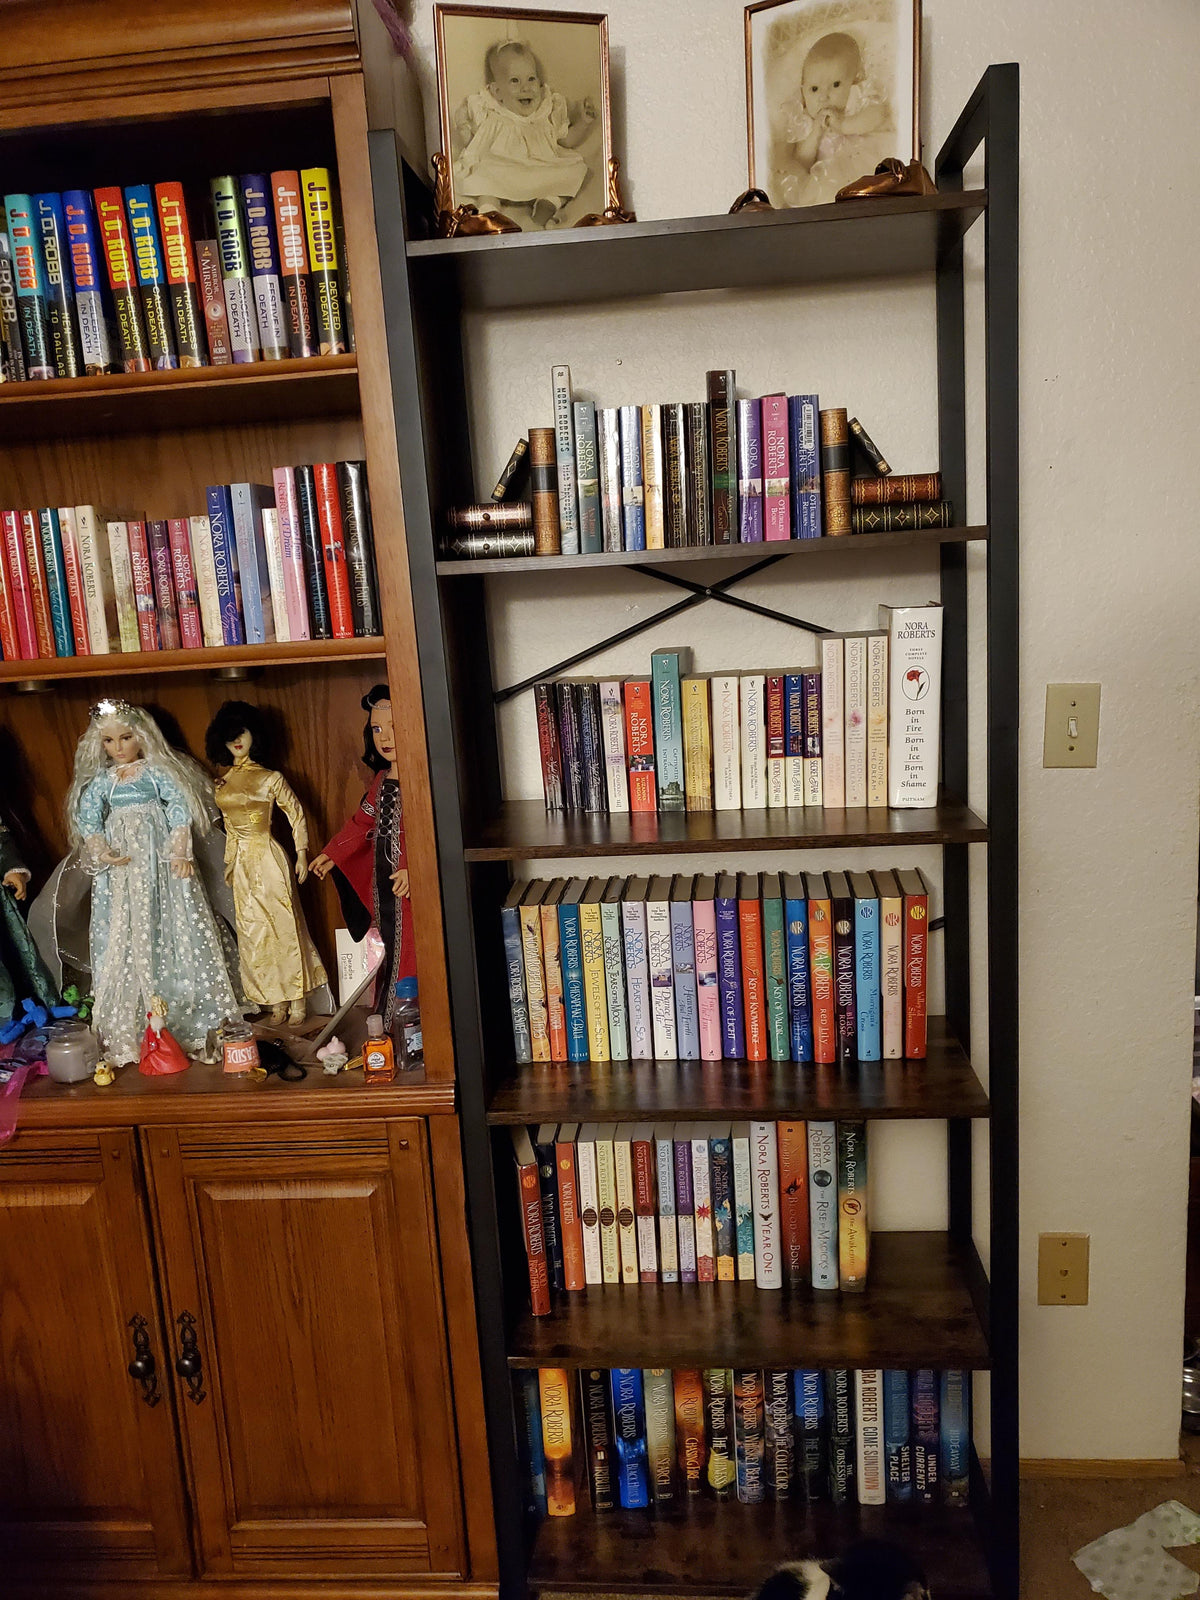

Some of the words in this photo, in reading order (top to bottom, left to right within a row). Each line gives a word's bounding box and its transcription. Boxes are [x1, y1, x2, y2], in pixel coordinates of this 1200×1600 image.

[166, 234, 189, 278] ROBB
[250, 226, 272, 269] ROBB
[282, 225, 303, 268] ROBB
[312, 220, 333, 263] ROBB
[107, 240, 130, 282] ROBB
[202, 259, 214, 302] MIRROR
[319, 282, 325, 293] IN
[51, 310, 58, 324] TO
[118, 300, 124, 310] IN
[259, 295, 269, 329] DEATH
[320, 297, 330, 330] DEATH
[330, 281, 340, 330] DEVOTED
[119, 313, 131, 350] DEATH
[54, 333, 65, 376] DALLAS
[715, 408, 730, 433] NORA
[577, 434, 586, 478] ROBERTS
[585, 440, 594, 471] NORA
[716, 437, 731, 471] ROBERTS
[749, 438, 758, 469] NORA
[768, 431, 777, 476] ROBERTS
[777, 436, 785, 468] NORA
[210, 512, 224, 547] NORA
[81, 535, 91, 559] NORA
[84, 562, 96, 598] ROBERTS
[132, 552, 144, 592] ROBERTS
[141, 558, 150, 585] NORA
[173, 548, 185, 588] ROBERTS
[182, 555, 191, 582] NORA
[215, 551, 230, 596] ROBERTS
[897, 630, 935, 639] ROBERTS
[904, 622, 928, 630] NORA
[872, 641, 880, 666] NORA
[660, 680, 670, 703] NORA
[872, 669, 880, 707] ROBERTS
[631, 712, 641, 752] ROBERTS
[639, 718, 648, 746] NORA
[661, 707, 672, 741] ROBERTS
[564, 918, 576, 937] NORA
[565, 940, 578, 968] ROBERTS
[583, 929, 594, 964] ROBERTS
[592, 932, 602, 960] NORA
[605, 936, 614, 970] ROBERTS
[611, 940, 620, 967] NORA
[625, 928, 636, 969] ROBERTS
[634, 932, 644, 965] NORA
[650, 931, 660, 968] ROBERTS
[661, 934, 670, 963] NORA
[696, 929, 707, 964] ROBERTS
[705, 933, 715, 960] NORA
[791, 946, 806, 969] NORA
[814, 935, 829, 960] NORA
[838, 946, 852, 970] NORA
[910, 934, 923, 954] NORA
[345, 953, 353, 980] Paradise
[908, 958, 925, 987] ROBERTS
[590, 969, 600, 1000] JEWELS
[632, 978, 642, 1004] HEART
[774, 987, 782, 1000] KEY
[790, 972, 807, 1006] ROBERTS
[814, 963, 830, 1000] ROBERTS
[835, 972, 853, 1006] ROBERTS
[594, 1002, 600, 1011] OF
[655, 994, 663, 1005] The
[662, 990, 671, 1016] Dance
[725, 990, 736, 1005] KEY
[728, 1007, 735, 1016] OF
[775, 1002, 782, 1010] OF
[655, 1007, 664, 1024] Air
[663, 1018, 673, 1039] Upon
[727, 1018, 736, 1040] LIGHT
[775, 1011, 784, 1035] VALOR
[594, 1027, 605, 1047] SUN
[635, 1026, 645, 1042] SEA
[636, 1146, 646, 1168] NORA
[757, 1135, 769, 1164] NORA
[810, 1129, 822, 1168] ROBERTS
[822, 1135, 833, 1164] NORA
[845, 1132, 856, 1158] NORA
[638, 1171, 646, 1204] ROBERTS
[757, 1169, 771, 1209] ROBERTS
[846, 1160, 857, 1195] ROBERTS
[526, 1201, 538, 1224] NORA
[528, 1226, 543, 1255] ROBERTS
[761, 1223, 773, 1249] YEAR
[764, 1252, 774, 1274] ONE
[545, 1383, 563, 1407] NORA
[620, 1376, 635, 1402] NORA
[710, 1373, 725, 1395] NORA
[741, 1373, 757, 1395] NORA
[772, 1373, 788, 1395] NORA
[803, 1373, 818, 1395] NORA
[835, 1370, 847, 1394] NORA
[708, 1397, 728, 1429] ROBERTS
[739, 1397, 758, 1430] ROBERTS
[768, 1397, 788, 1429] ROBERTS
[800, 1397, 819, 1430] ROBERTS
[837, 1396, 848, 1433] ROBERTS
[862, 1387, 878, 1422] ROBERTS
[543, 1410, 564, 1444] ROBERTS
[617, 1403, 636, 1438] ROBERTS
[713, 1436, 728, 1449] THE
[776, 1436, 787, 1447] THE
[863, 1427, 878, 1448] COME
[949, 1429, 960, 1471] HIDEAWAY
[656, 1458, 670, 1485] SEARCH
[686, 1466, 700, 1480] FIRE
[775, 1450, 789, 1491] COLLECTOR
[836, 1449, 846, 1492] OBSESSION
[864, 1450, 879, 1490] SUNDOWN
[890, 1455, 899, 1482] PLACE
[901, 1446, 910, 1482] SHELTER
[915, 1446, 925, 1490] CURRENTS
[928, 1454, 936, 1482] UNDER
